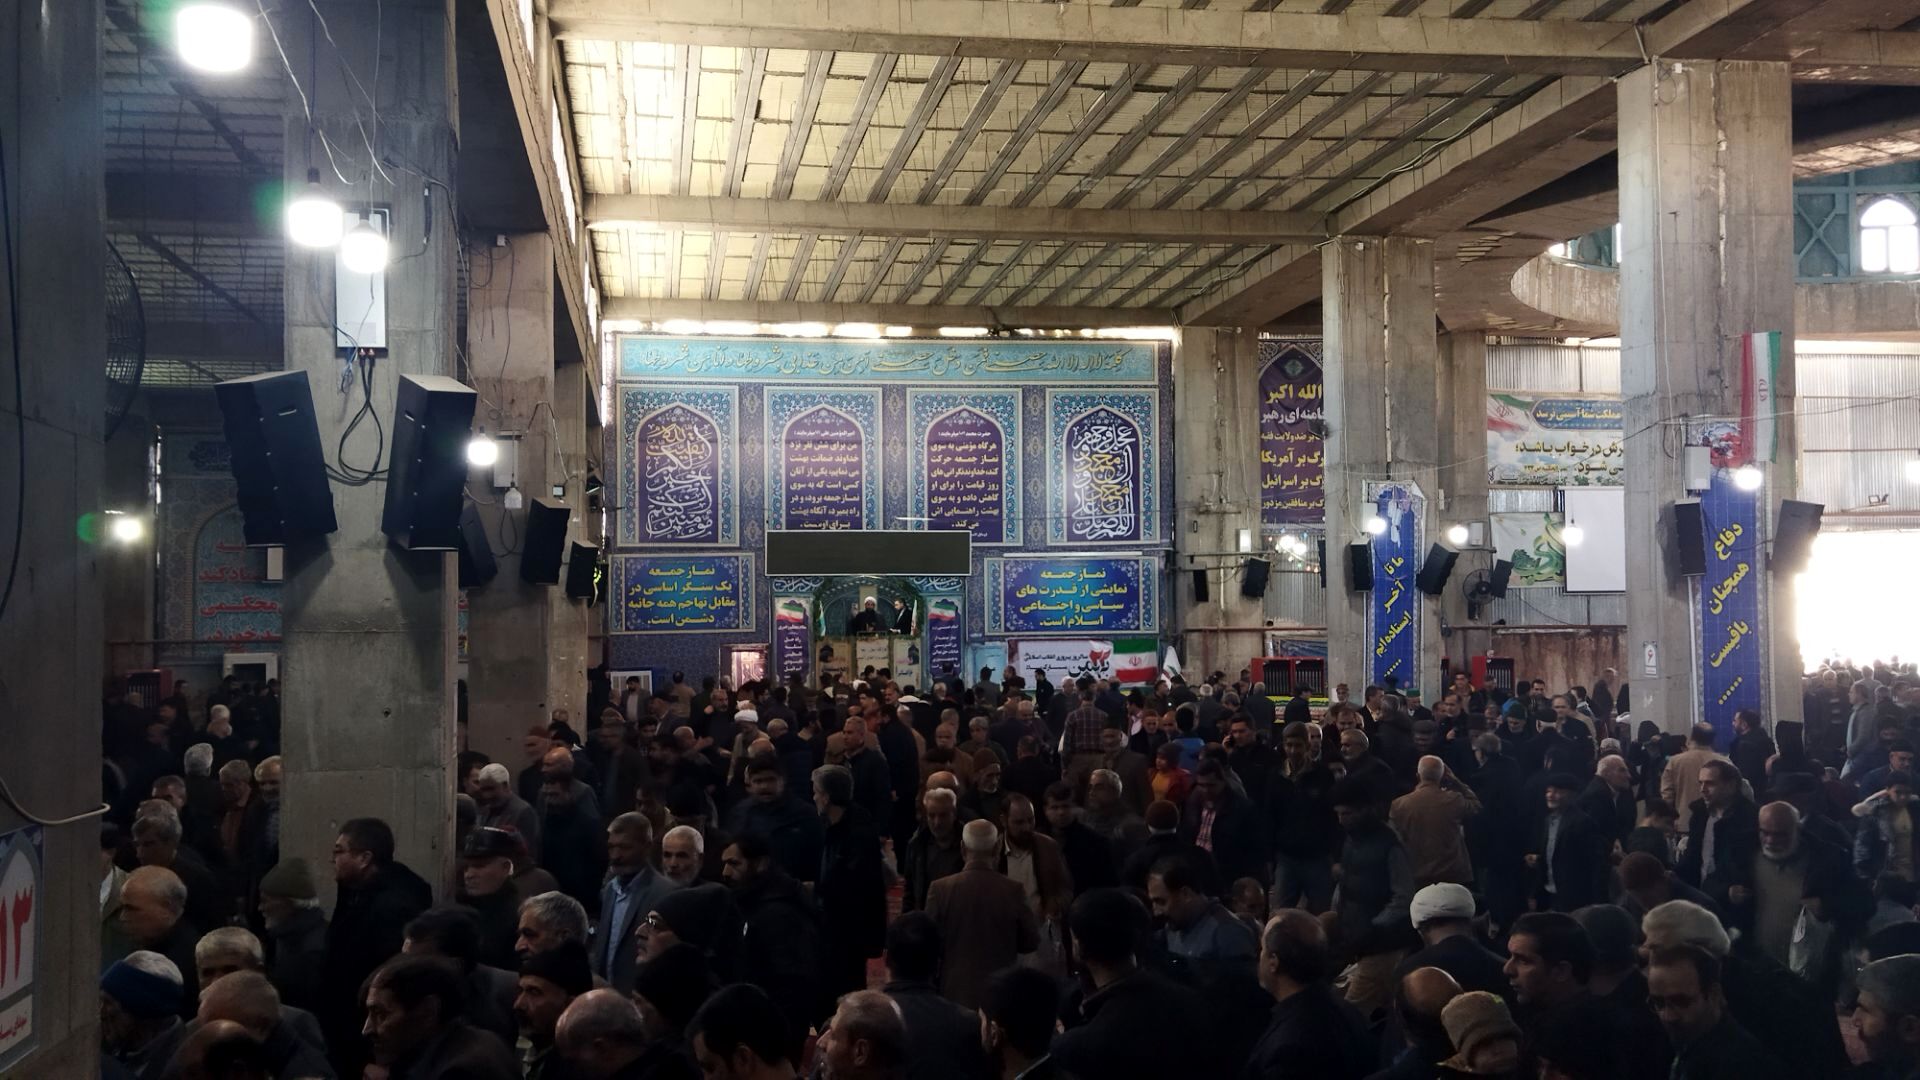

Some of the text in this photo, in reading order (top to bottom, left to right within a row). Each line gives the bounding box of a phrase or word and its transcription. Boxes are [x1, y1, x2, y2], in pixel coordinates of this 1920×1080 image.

[1265, 383, 1323, 404] الله اکبر
[1261, 407, 1285, 424] رهبر
[1301, 407, 1324, 424] امنه
[830, 441, 846, 451] برای
[931, 441, 946, 451] سوی
[948, 441, 955, 451] به
[1554, 442, 1589, 457] خواب
[790, 454, 809, 464] بهشت
[835, 454, 859, 464] خداوند
[931, 454, 999, 465] نماز جمعه حرکت
[1260, 447, 1311, 468] بر آمریکا
[1590, 447, 1602, 459] در
[790, 480, 860, 490] کسی است که به سوی
[940, 480, 955, 491] برای
[957, 480, 964, 491] را
[966, 480, 985, 491] قیامت
[987, 480, 999, 491] روز
[1261, 474, 1298, 491] اسرائیل
[1298, 477, 1310, 491] بر
[790, 494, 799, 504] در
[823, 494, 841, 504] جمعه
[841, 494, 860, 504] نماز
[931, 493, 946, 504] سوی
[948, 493, 955, 504] به
[962, 493, 977, 504] داده
[849, 506, 860, 517] راه
[829, 520, 850, 530] برای
[968, 520, 979, 529] می
[1714, 522, 1744, 561] دفاع
[648, 564, 715, 579] نماز جمعه
[1383, 555, 1405, 579] ما تا
[1040, 568, 1106, 582] نماز جمعه
[628, 581, 732, 595] یک سنگر اساسی در
[1016, 583, 1128, 598] نمایشی از قدرت های
[1708, 562, 1750, 615] همچنان
[628, 596, 655, 611] جانبه
[656, 596, 677, 611] همه
[708, 596, 737, 611] مقابل
[1019, 600, 1073, 614] اجتماعی
[1081, 600, 1124, 614] سیاسی
[675, 613, 715, 627] دشمن
[1067, 616, 1104, 629] اسلام
[1710, 621, 1752, 669] باقیست
